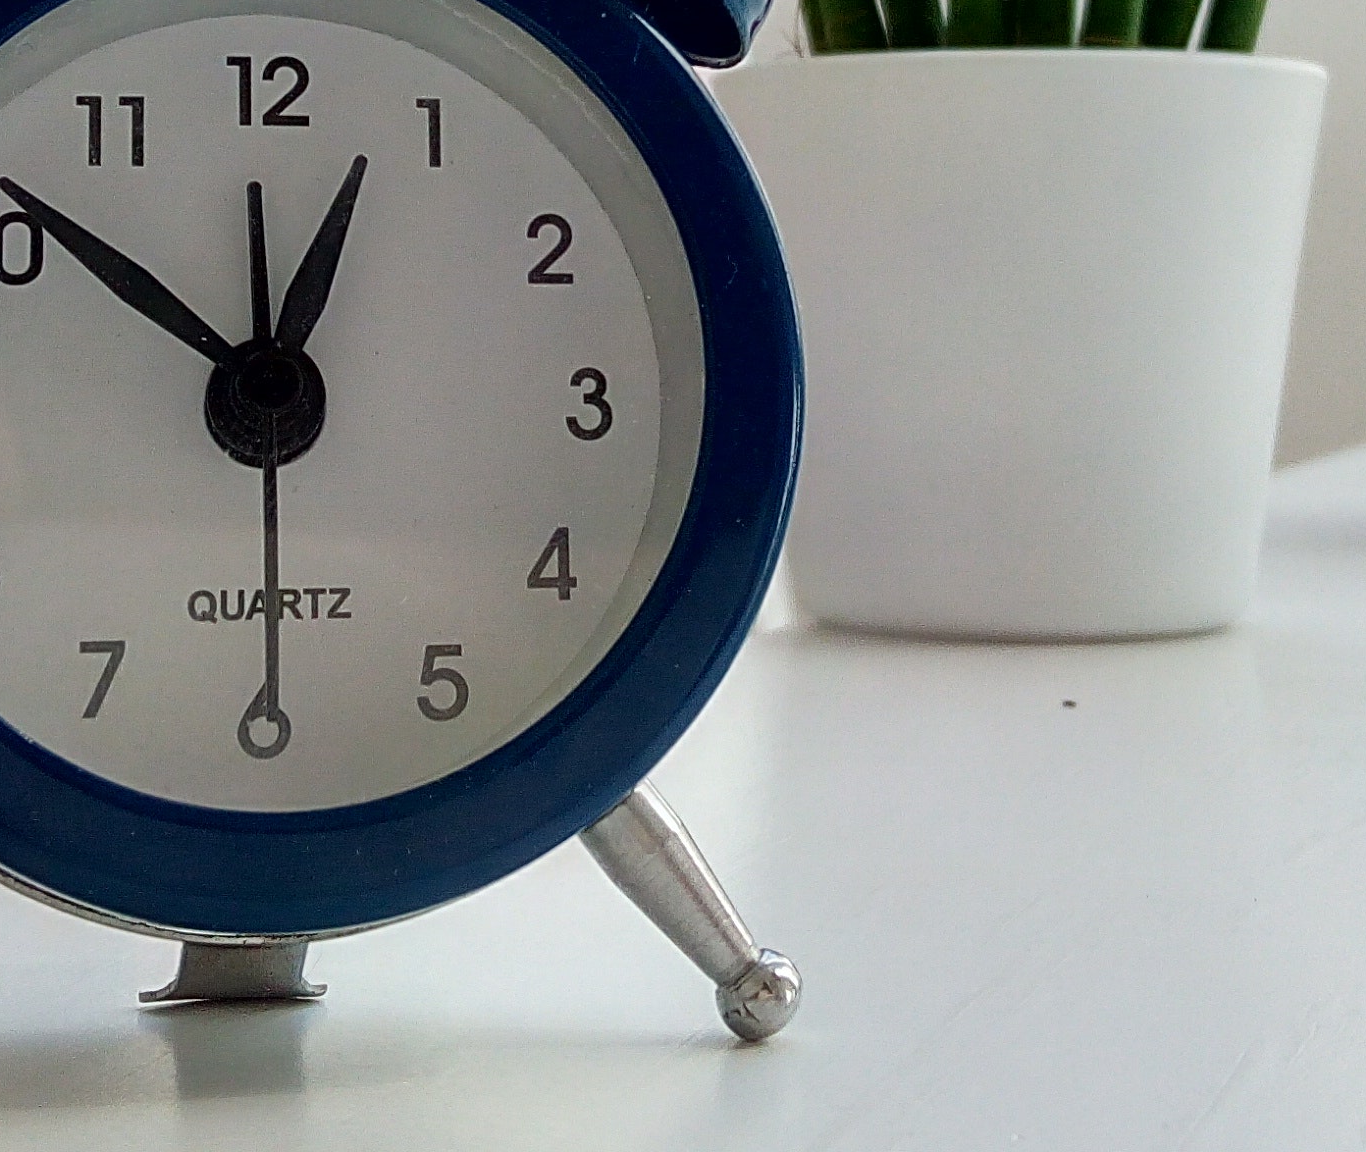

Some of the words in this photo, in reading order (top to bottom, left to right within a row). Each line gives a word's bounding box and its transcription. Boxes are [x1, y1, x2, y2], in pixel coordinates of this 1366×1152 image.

[226, 56, 310, 127] 12
[75, 95, 145, 167] 11
[416, 98, 442, 168] 1
[526, 213, 574, 285] 2
[565, 367, 613, 441] 3
[527, 526, 578, 601] 4
[187, 587, 352, 624] QUARTZ
[79, 640, 126, 719] 7
[416, 643, 470, 722] 5
[237, 680, 292, 760] 6
